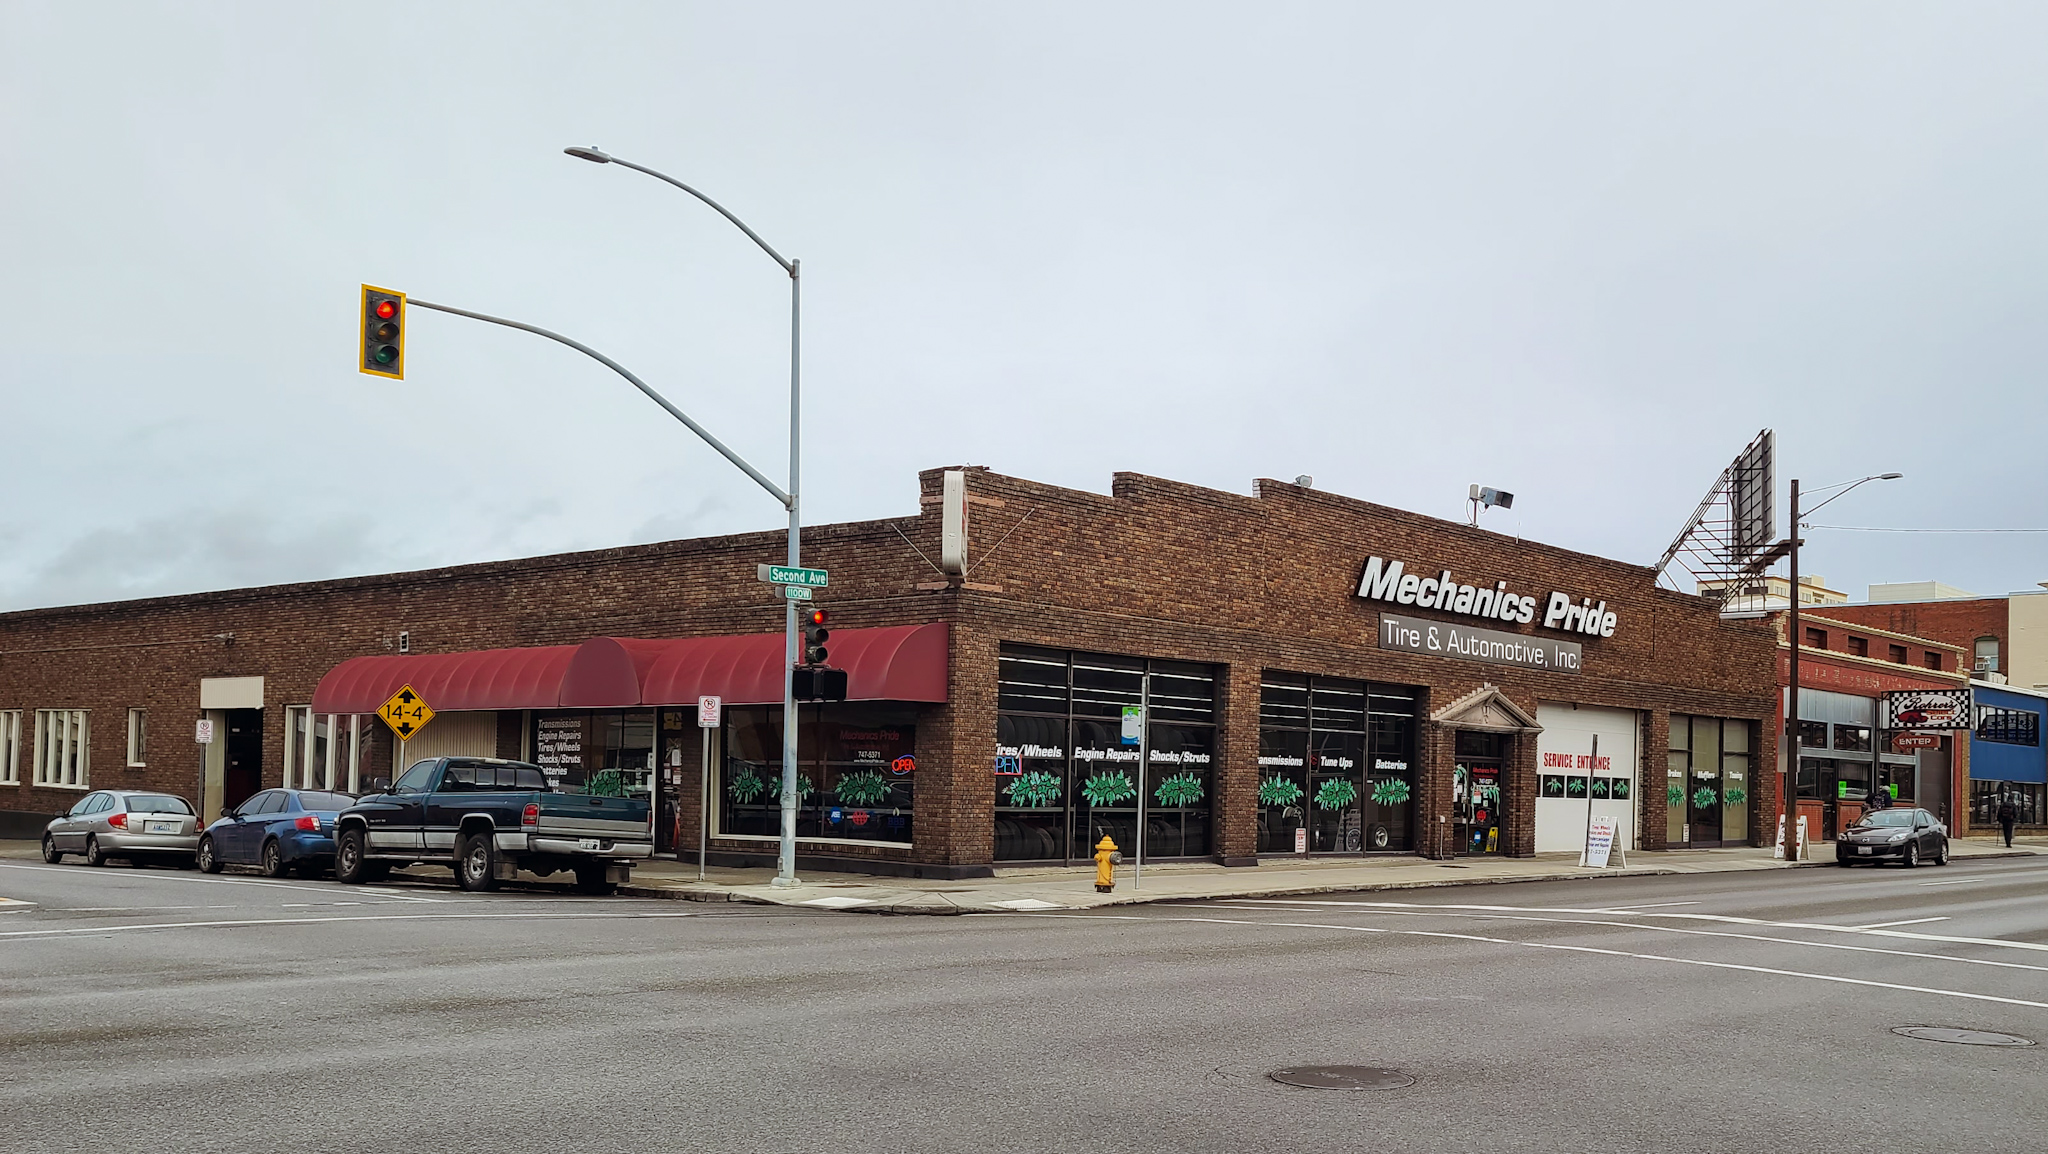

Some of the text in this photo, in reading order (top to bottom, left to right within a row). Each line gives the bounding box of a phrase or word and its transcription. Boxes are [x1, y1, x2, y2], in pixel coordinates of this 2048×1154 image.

[772, 568, 826, 584] Second Ave
[1358, 556, 1617, 637] Mechanics Pride
[1384, 619, 1580, 669] Tire & Automotive, Inc.
[1904, 697, 1957, 709] Rohrer's
[538, 719, 581, 729] Transmissions
[538, 730, 581, 742] Engine Repairs
[538, 742, 581, 753] Tires/Wheels
[996, 743, 1062, 759] ires/Wheels
[537, 754, 581, 766] Shocks/Struts
[1074, 747, 1140, 763] Engine Repairs
[1150, 750, 1210, 765] Shocks/Struts
[1257, 755, 1303, 766] ansmissions
[1544, 752, 1572, 768] SERVICE
[892, 758, 916, 772] OPEN
[995, 756, 1020, 773] PEN
[1320, 756, 1353, 769] Tune Ups
[1375, 759, 1407, 770] Batteries
